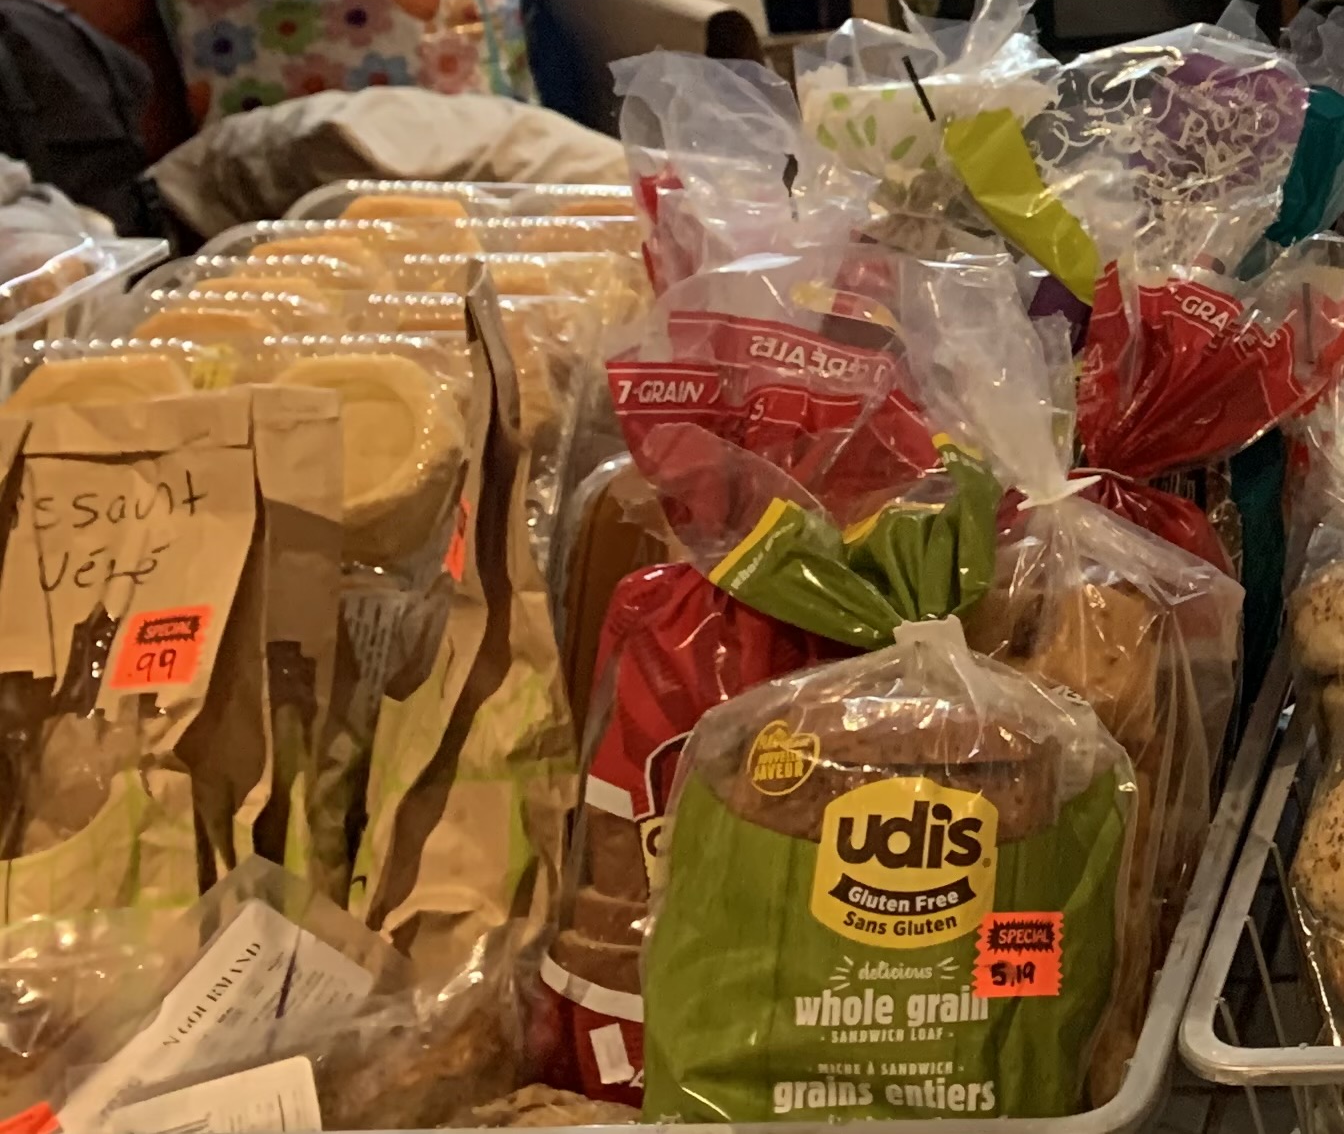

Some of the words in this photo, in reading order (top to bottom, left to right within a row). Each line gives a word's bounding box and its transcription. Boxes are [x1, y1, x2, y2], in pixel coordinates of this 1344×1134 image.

[1173, 295, 1231, 333] -GRA
[617, 379, 705, 405] 7-GRAIN
[848, 886, 907, 913] Gluten
[915, 888, 960, 912] Free
[843, 910, 888, 935] Sans
[895, 915, 958, 937] Gluten
[998, 928, 1051, 945] SPECIAL
[857, 960, 934, 981] delicious
[794, 987, 895, 1027] whole
[906, 984, 989, 1027] grain
[830, 1029, 905, 1044] SANDWICH
[909, 1027, 944, 1041] LOAF
[880, 1061, 954, 1076] SANDWICH
[772, 1075, 875, 1115] grains
[884, 1077, 996, 1113] entiers
